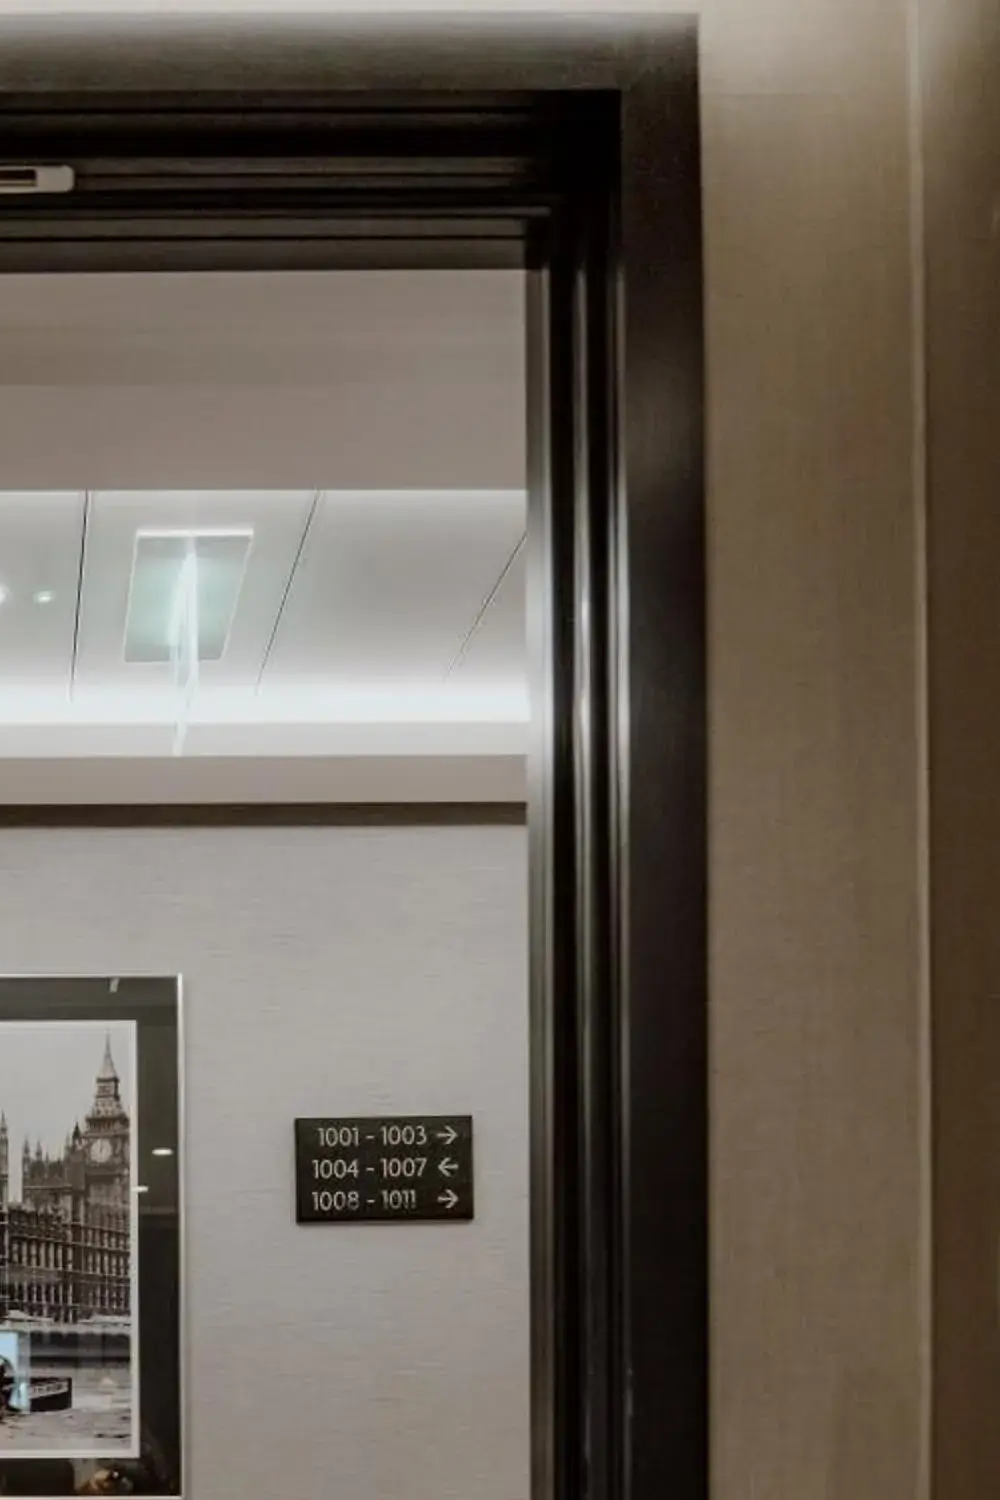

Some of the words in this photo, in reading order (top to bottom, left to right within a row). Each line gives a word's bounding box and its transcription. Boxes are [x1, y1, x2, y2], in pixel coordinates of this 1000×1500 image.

[318, 1127, 360, 1147] 1001
[380, 1125, 428, 1145] 1003
[311, 1159, 360, 1179] 1004
[380, 1158, 428, 1178] 1007
[311, 1191, 360, 1211] 1008
[381, 1189, 417, 1210] 1011
